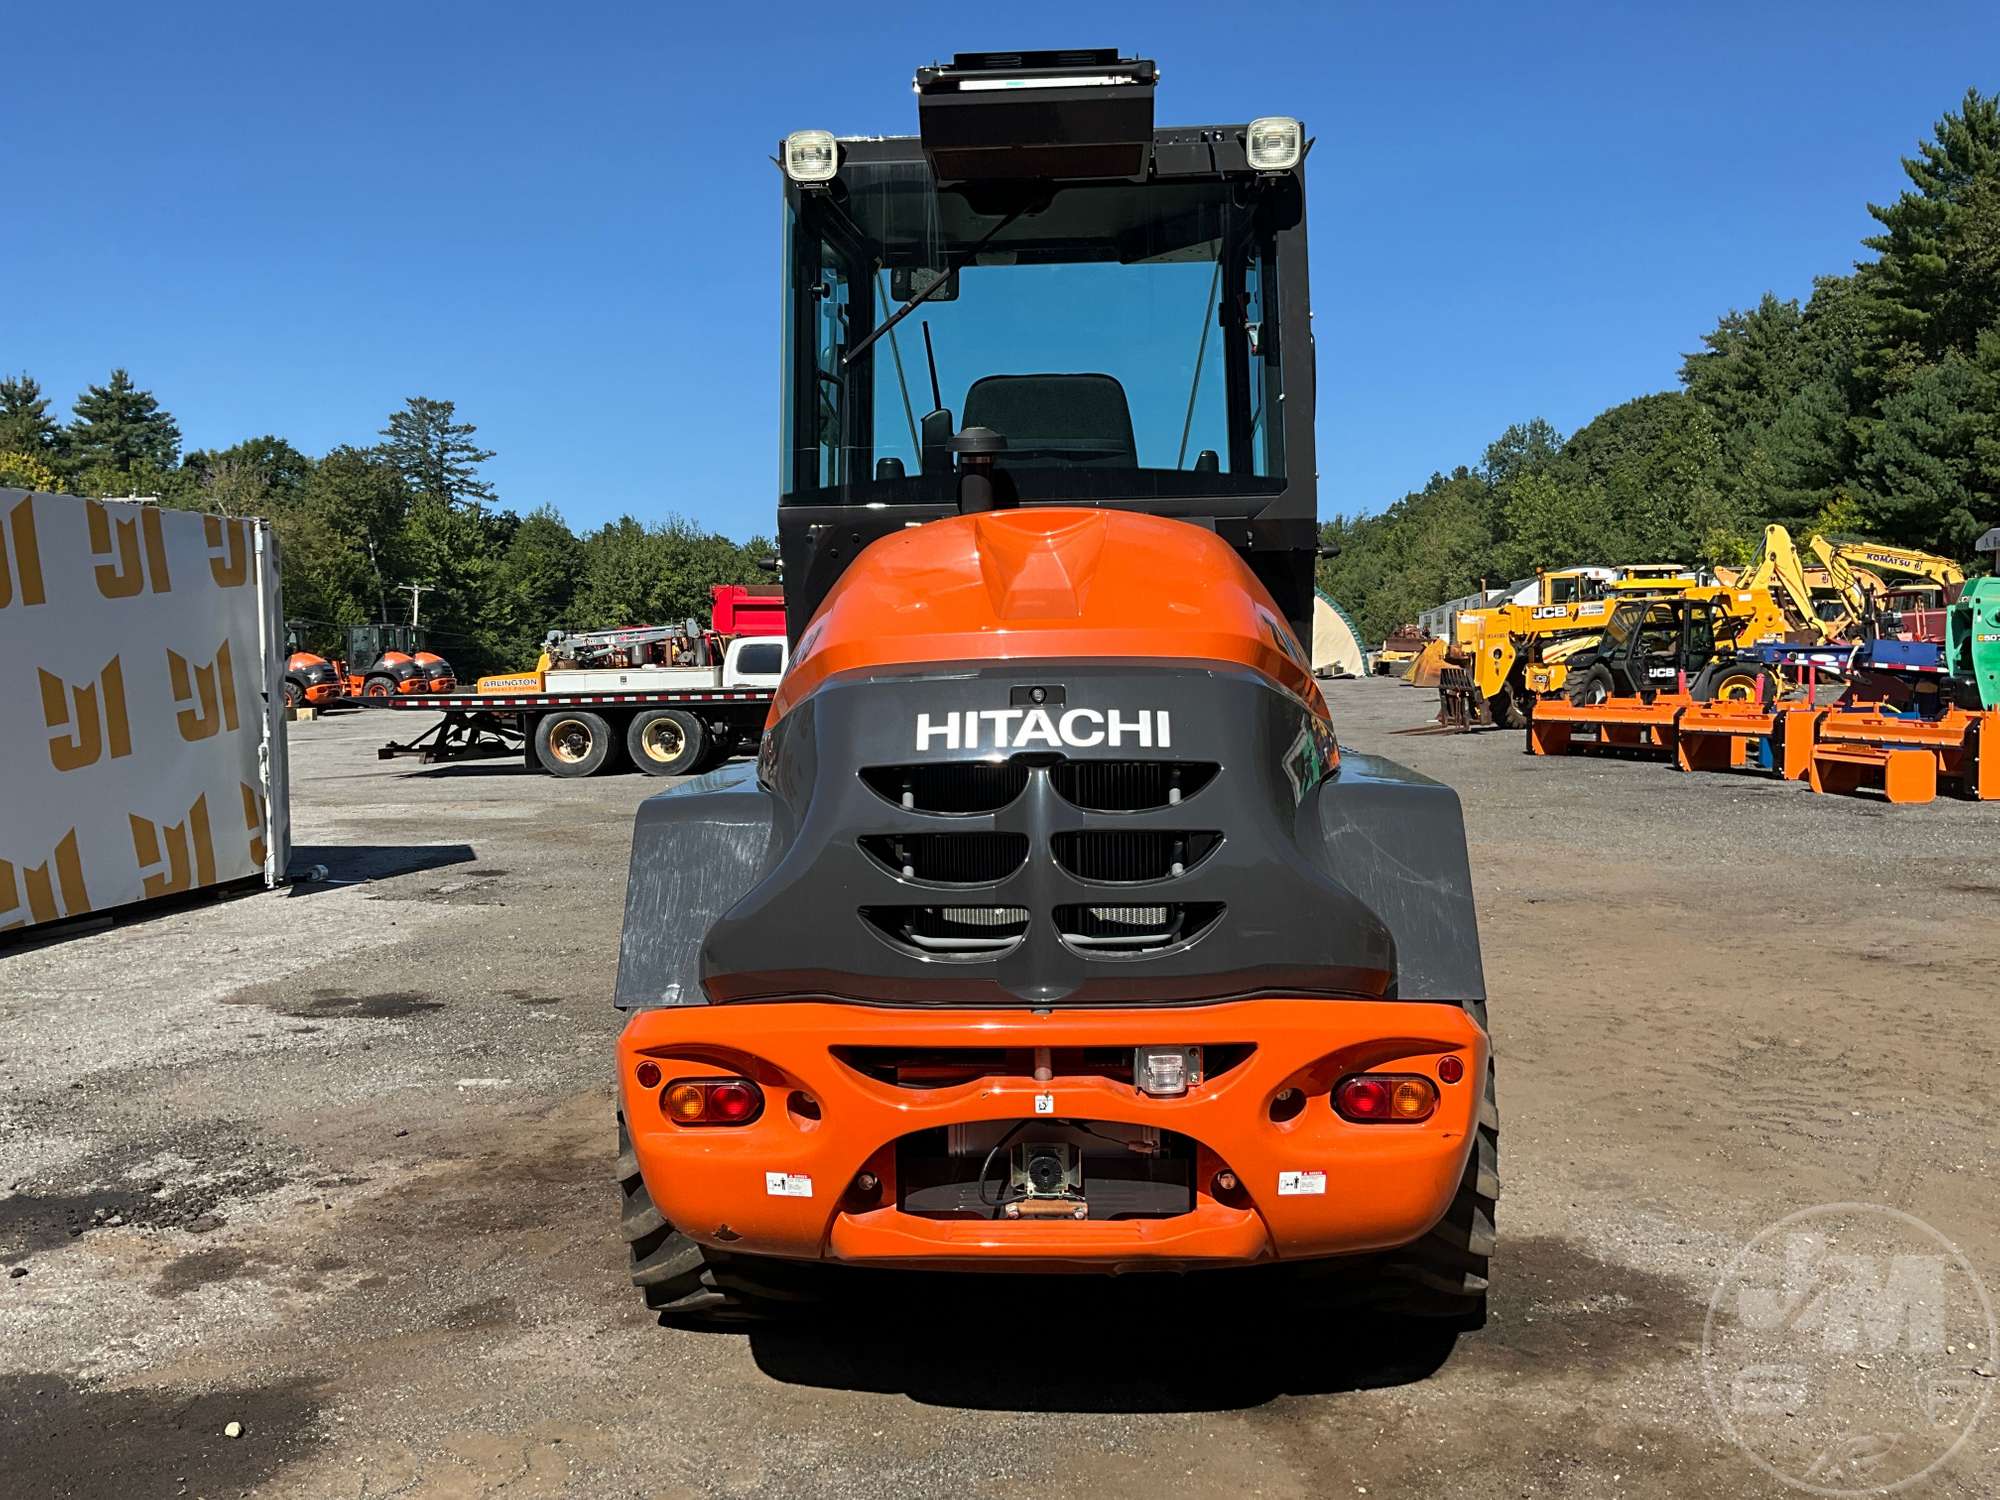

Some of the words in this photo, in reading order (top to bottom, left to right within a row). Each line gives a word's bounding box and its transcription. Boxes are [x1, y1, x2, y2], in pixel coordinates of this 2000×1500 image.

[1866, 552, 1911, 567] KOMATSU
[1532, 605, 1568, 620] JCB
[1649, 667, 1676, 678] JCB
[483, 679, 538, 687] ARLINGTON
[916, 708, 1171, 751] HITACHI
